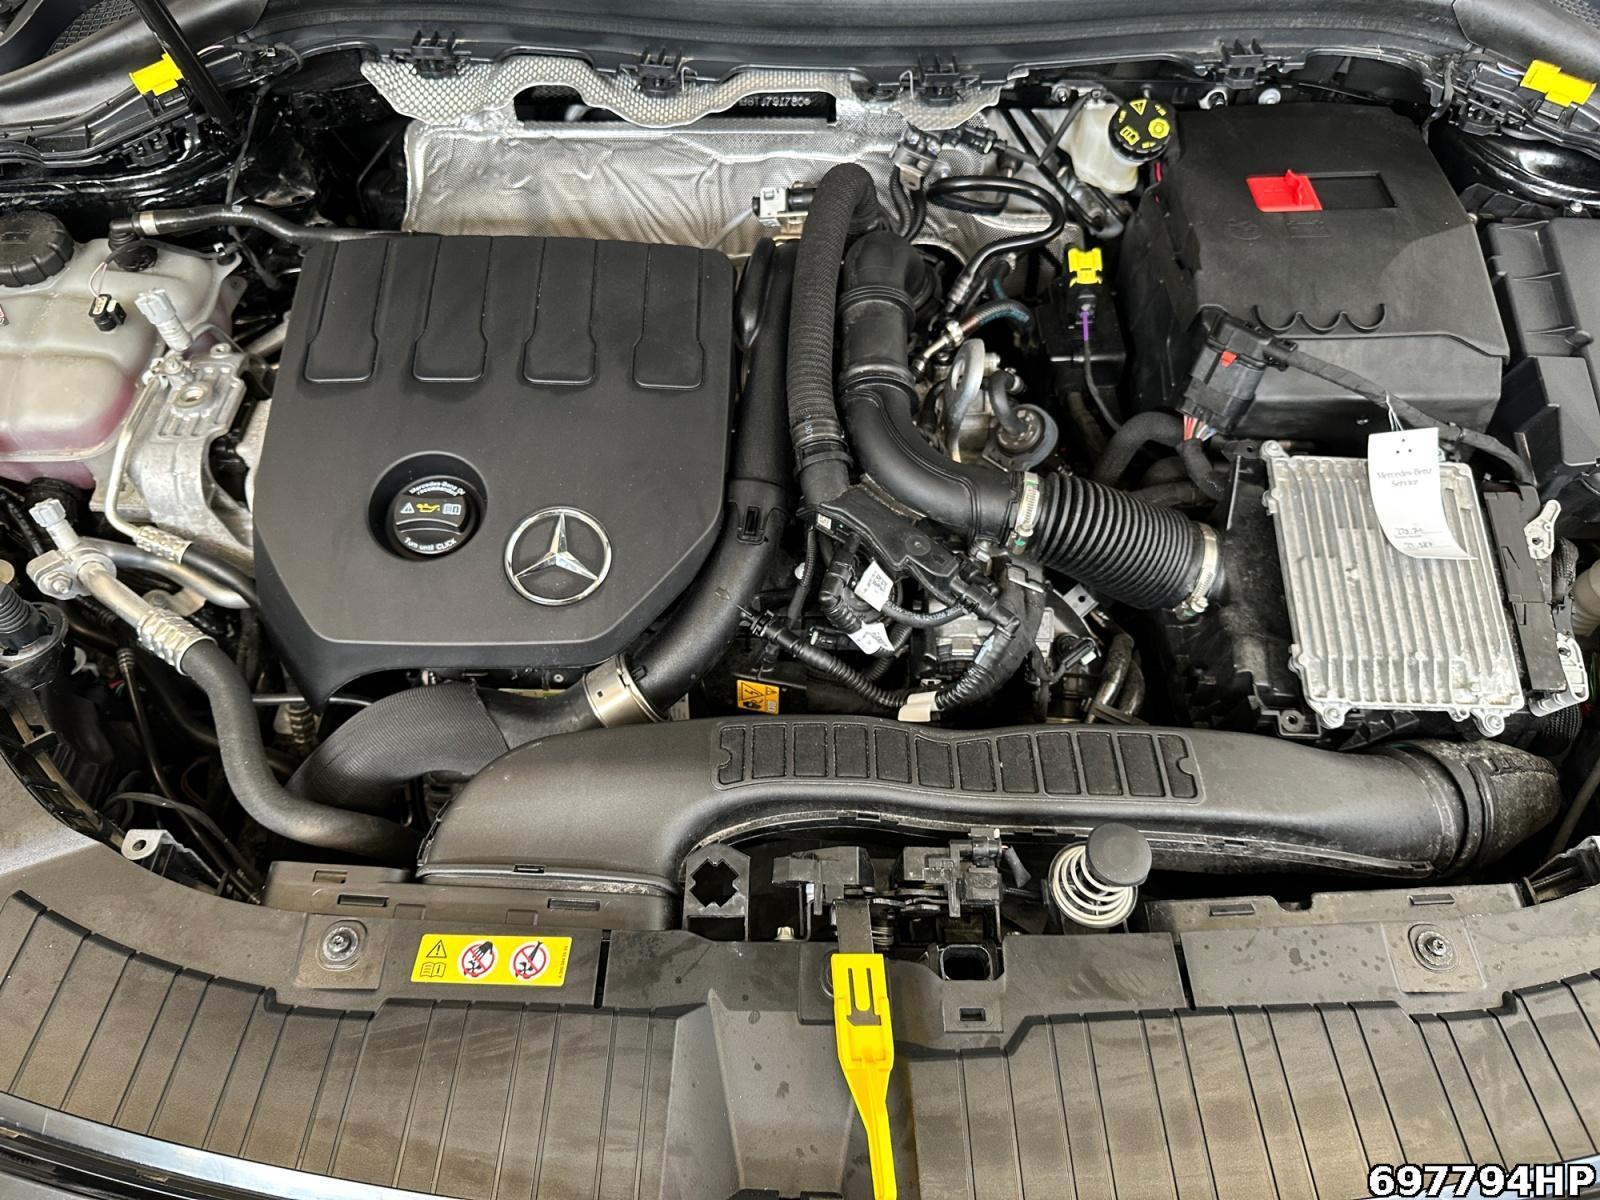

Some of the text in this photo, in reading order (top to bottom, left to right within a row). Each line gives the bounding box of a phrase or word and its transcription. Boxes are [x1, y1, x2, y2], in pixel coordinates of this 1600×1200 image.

[404, 537, 457, 551] Turn until CLICK
